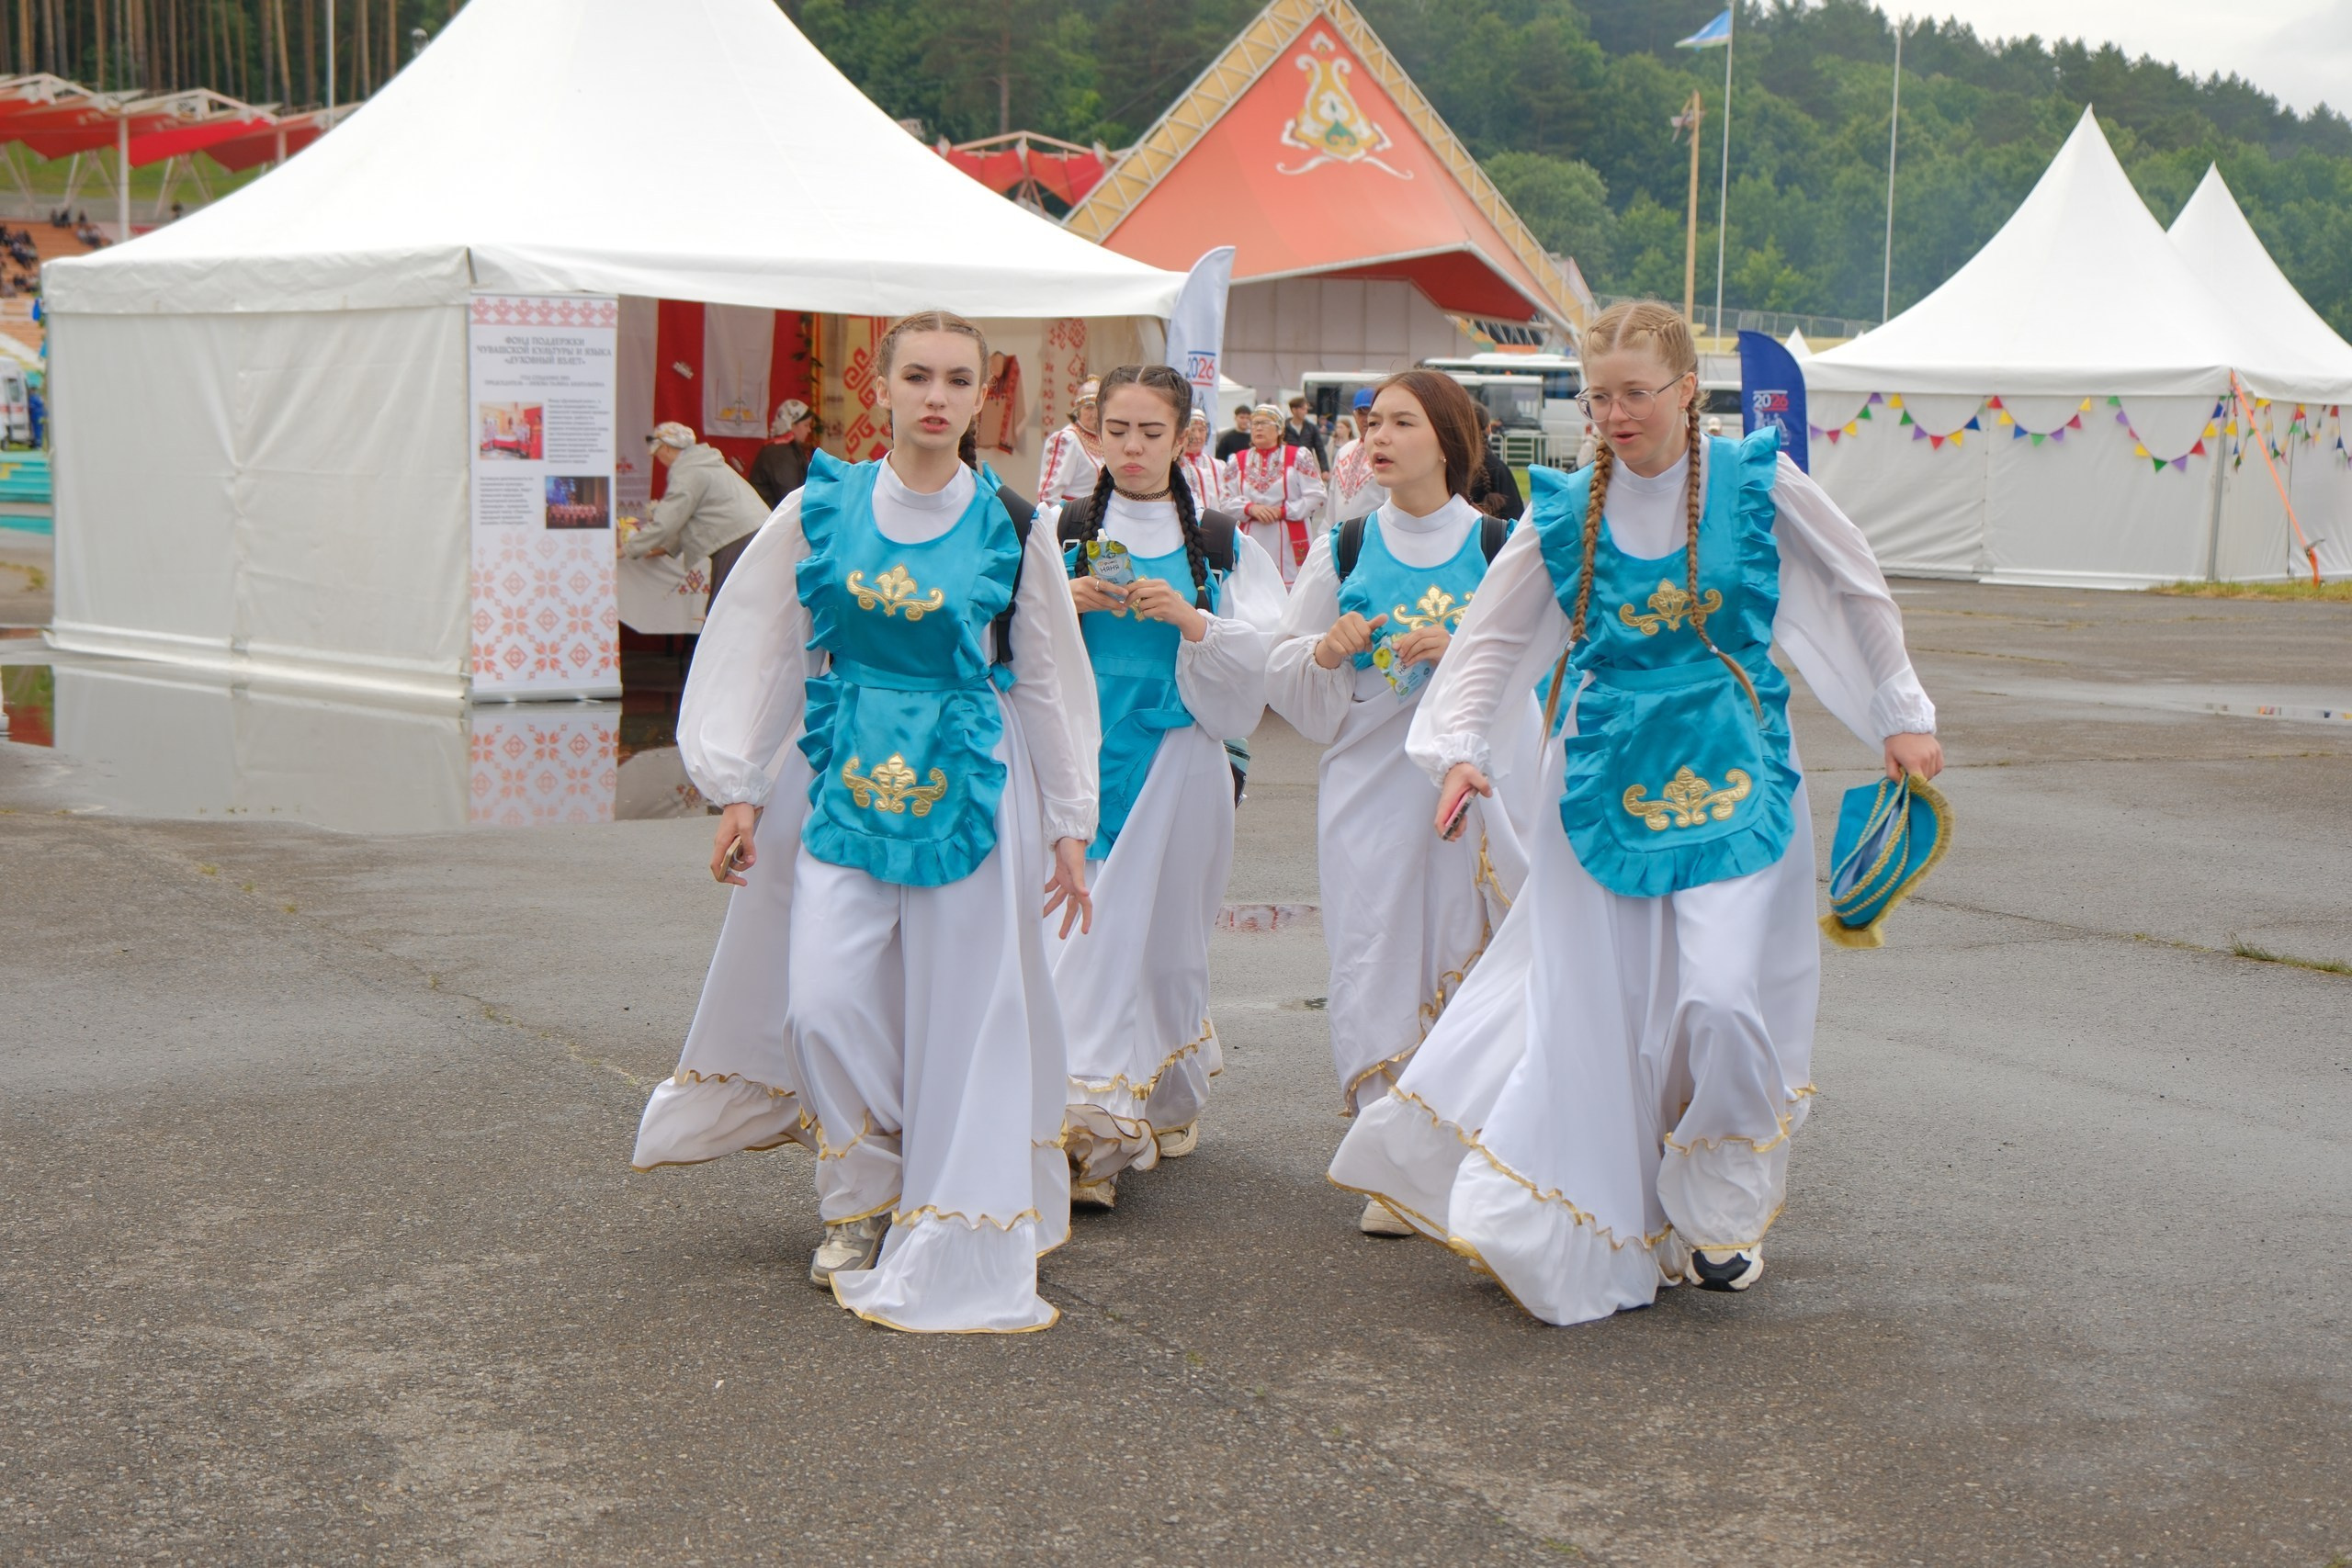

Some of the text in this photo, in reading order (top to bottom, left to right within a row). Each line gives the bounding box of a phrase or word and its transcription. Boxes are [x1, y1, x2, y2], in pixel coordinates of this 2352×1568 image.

[504, 336, 585, 346] ФОНД ПОДДЕРЖКИ
[477, 345, 612, 356] ЧУВАШСКОЙ КУЛЬТУРЫ И ЯЗЫКА
[1185, 356, 1215, 379] 2026
[1752, 394, 1789, 408] 2026
